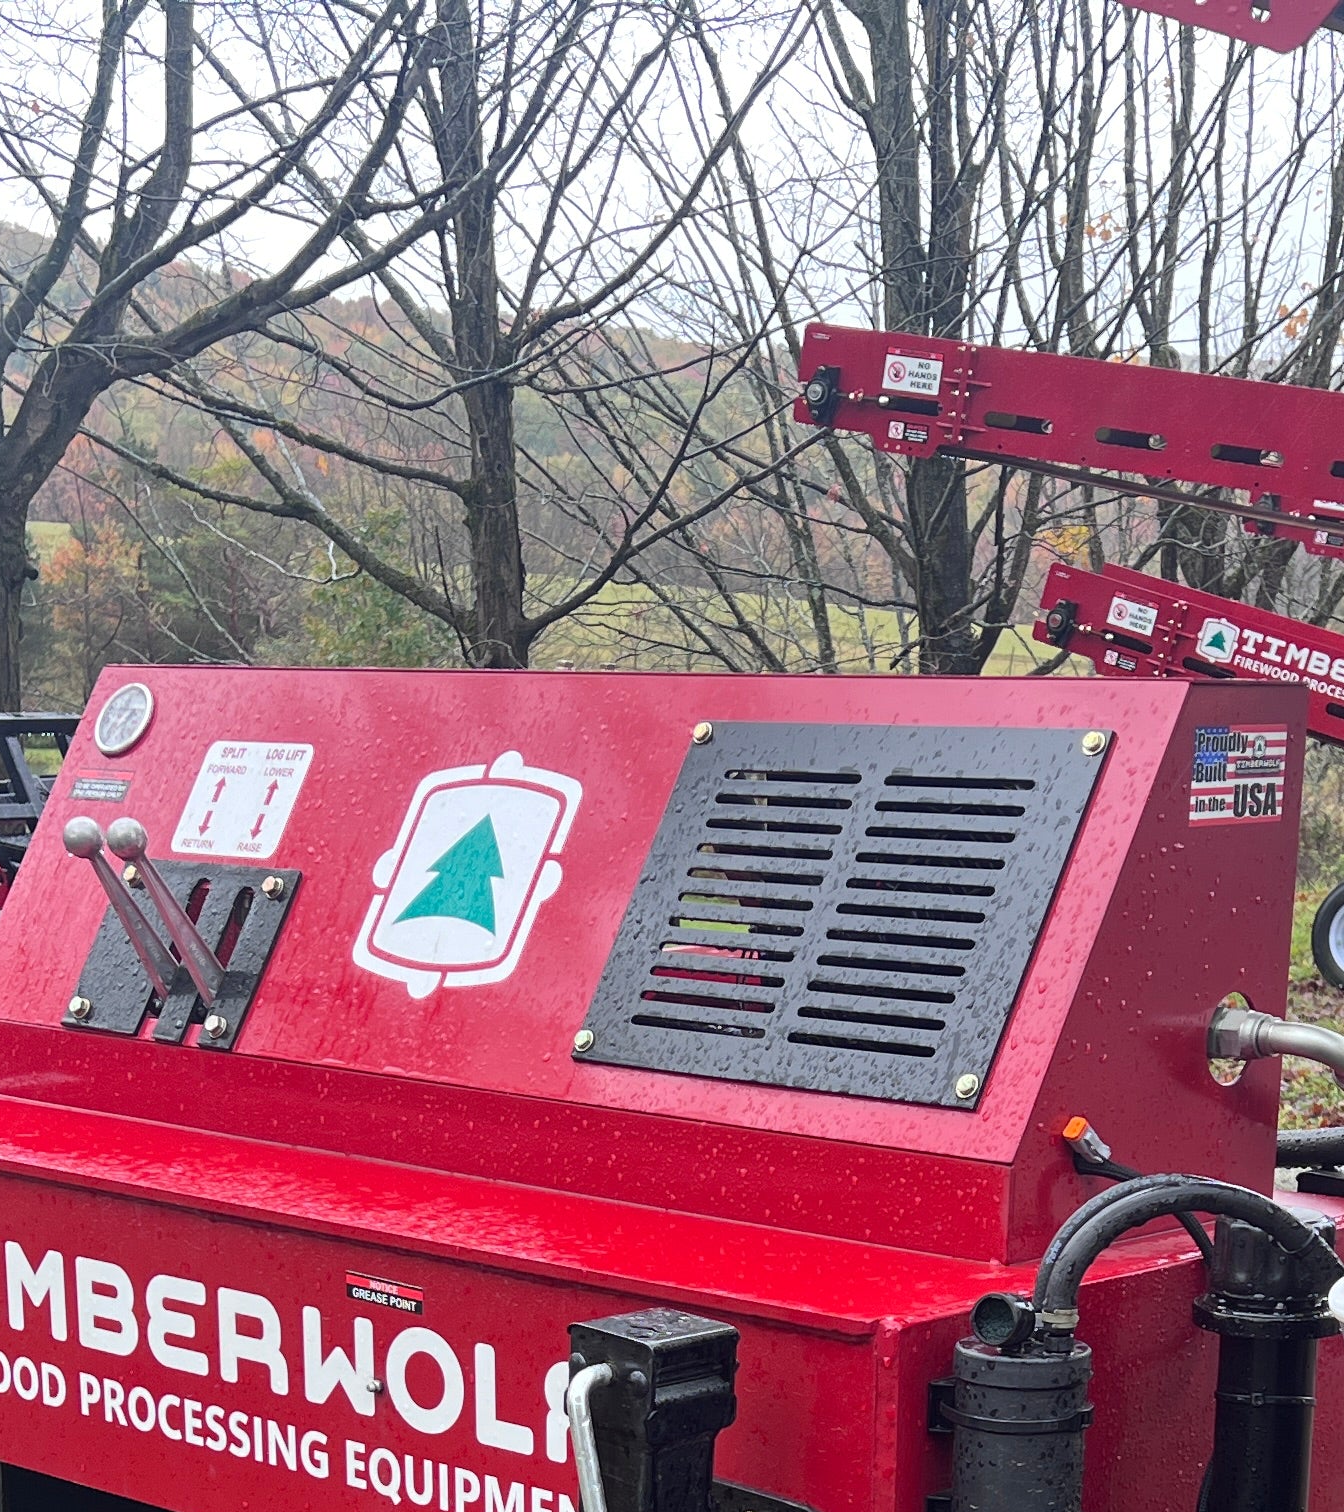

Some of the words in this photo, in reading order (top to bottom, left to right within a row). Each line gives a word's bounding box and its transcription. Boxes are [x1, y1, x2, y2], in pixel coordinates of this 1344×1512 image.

[918, 361, 931, 370] NO
[907, 370, 938, 381] HANDS
[909, 381, 934, 391] HERE
[1233, 654, 1300, 683] FIREWOOD
[1197, 732, 1249, 754] Proudly
[221, 747, 248, 759] SPLIT
[265, 749, 284, 760] LOG
[285, 750, 307, 761] LIFT
[207, 764, 248, 775] FORWARD
[263, 767, 295, 778] LOWER
[1195, 762, 1227, 783] Built
[1195, 797, 1205, 813] in
[1208, 797, 1226, 812] the
[1233, 782, 1277, 818] USA
[181, 838, 215, 849] RETURN
[236, 841, 263, 853] RAISE
[369, 1281, 399, 1295] NOTICE
[352, 1287, 388, 1306] GREASE
[389, 1295, 417, 1312] POINT
[79, 1371, 330, 1480] PROCESSING
